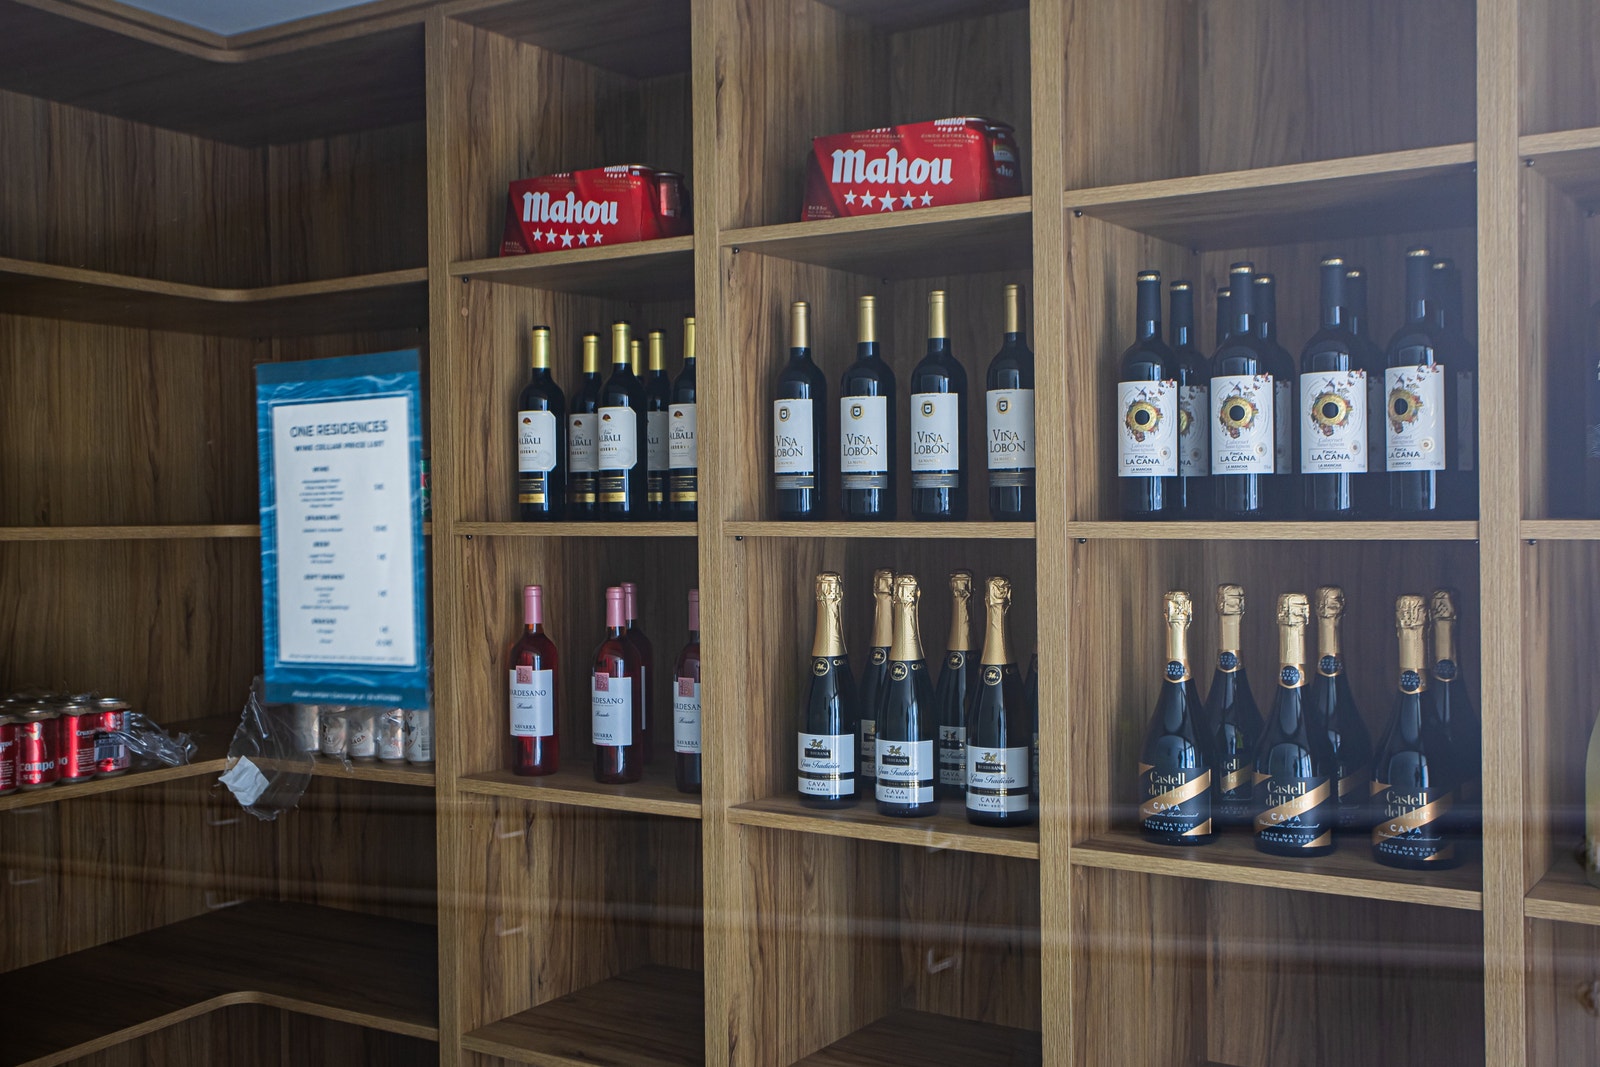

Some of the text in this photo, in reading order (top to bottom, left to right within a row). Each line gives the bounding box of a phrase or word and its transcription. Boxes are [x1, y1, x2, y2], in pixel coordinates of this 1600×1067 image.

[831, 148, 954, 185] Mahou
[522, 191, 618, 224] Mahou
[290, 420, 388, 438] ONE RESIDENCES
[992, 429, 1019, 441] VIÑA
[776, 435, 798, 447] VIÑA
[846, 433, 872, 445] VIÑA
[917, 431, 943, 443] VIÑA
[19, 760, 54, 772] campo
[1149, 771, 1186, 785] Castell
[1267, 781, 1306, 794] Castell
[1386, 791, 1427, 805] Castell
[1153, 802, 1180, 811] CAVA
[1271, 813, 1300, 822] CAVA
[1390, 824, 1421, 834] CAVA
[1379, 847, 1414, 856] RESERVA
